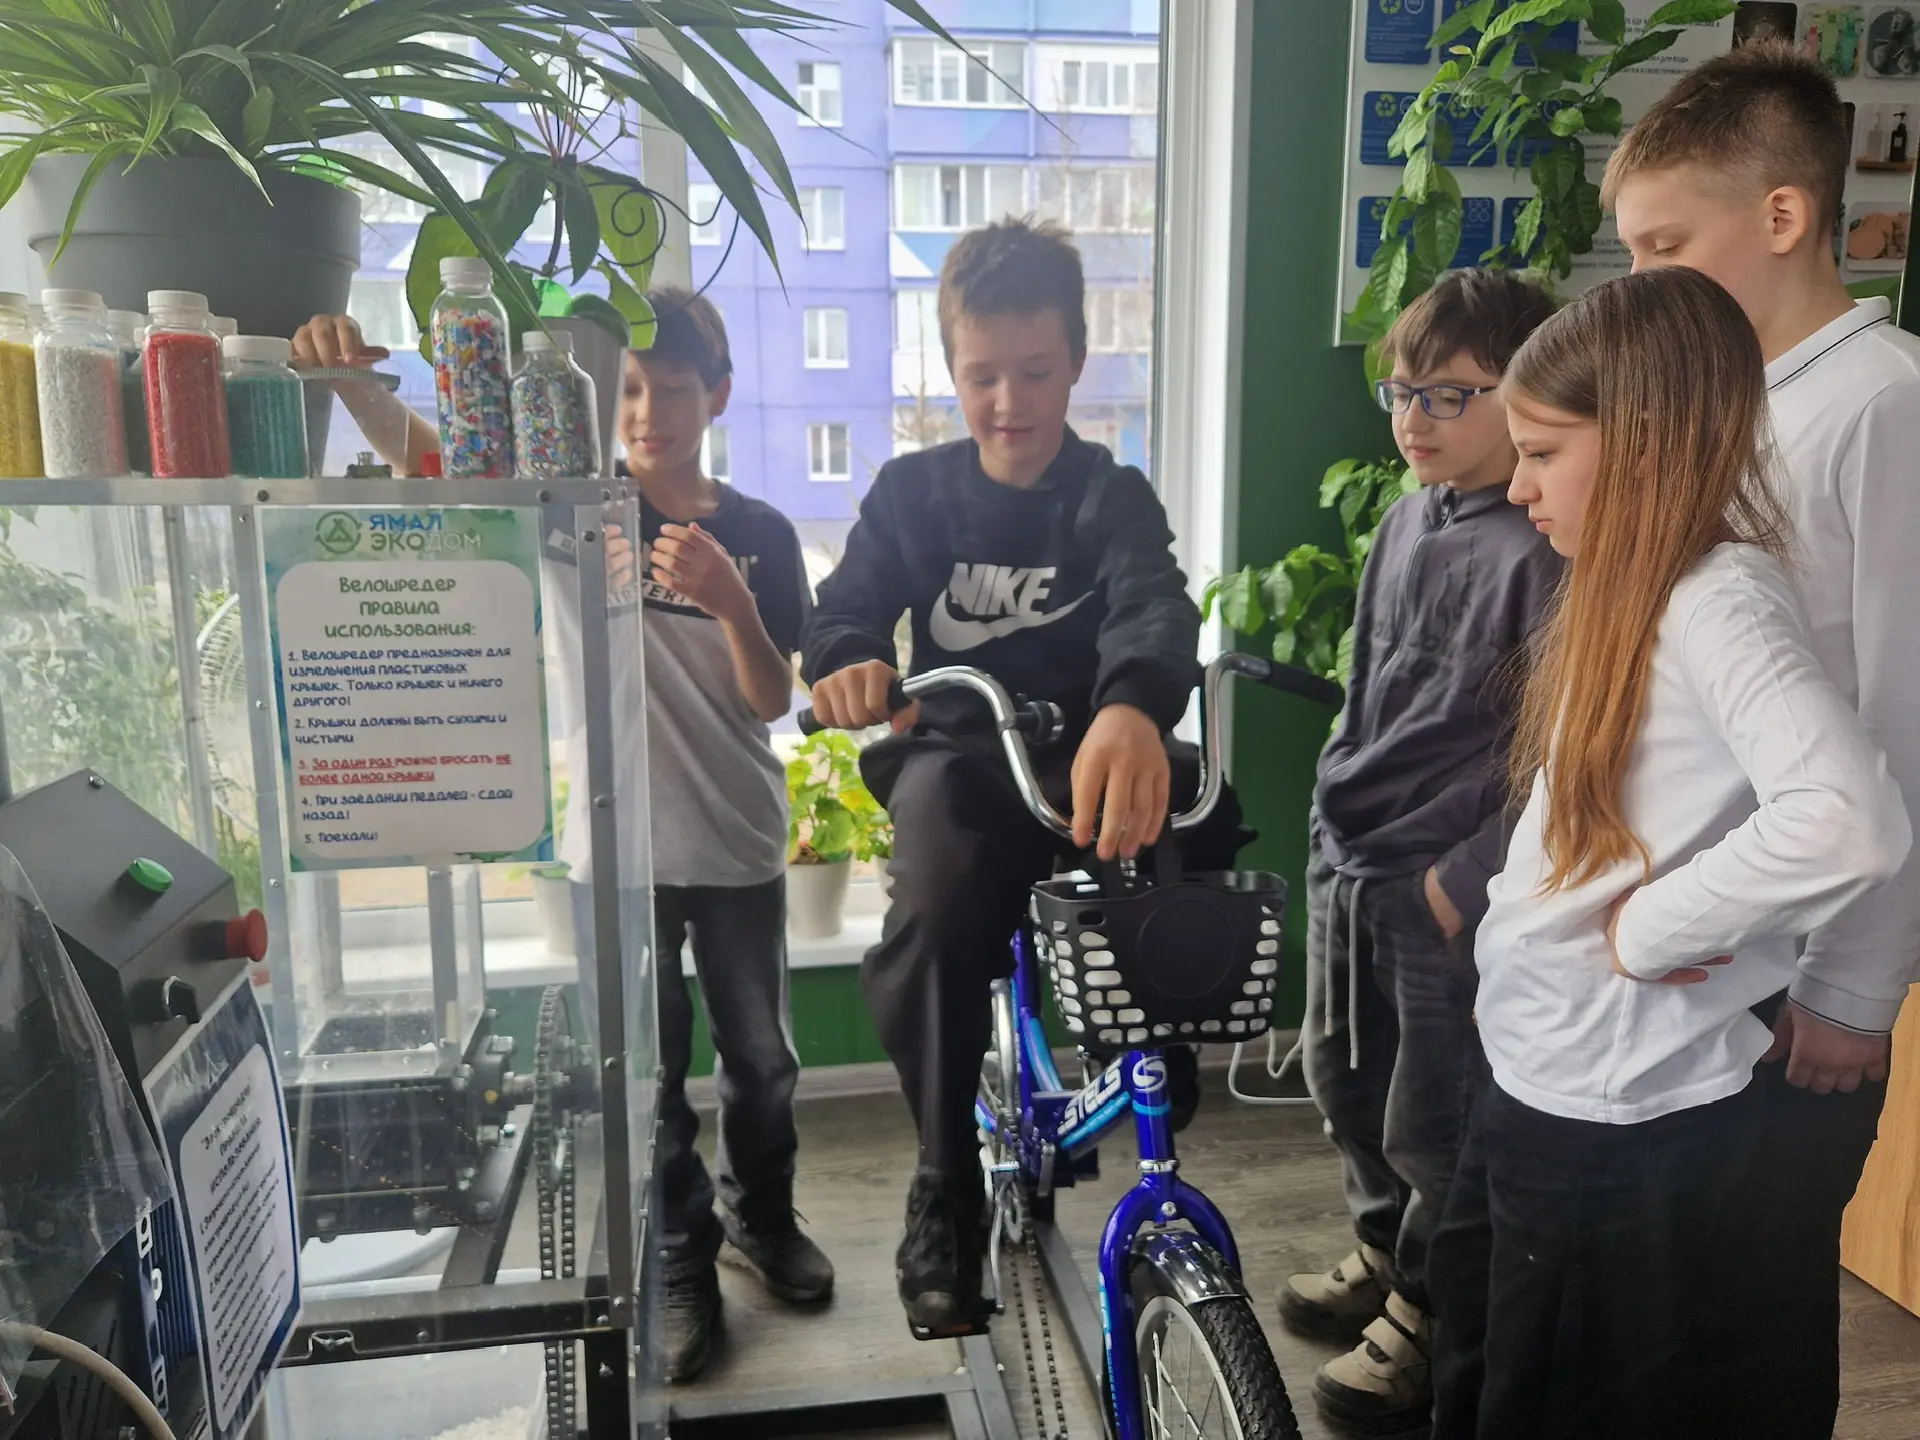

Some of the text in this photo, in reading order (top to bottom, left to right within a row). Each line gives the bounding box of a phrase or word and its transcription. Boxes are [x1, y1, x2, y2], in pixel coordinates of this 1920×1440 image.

[368, 513, 443, 531] ЯМАЛ
[371, 531, 482, 551] ЭКОДОМ
[339, 576, 457, 593] Велошредер
[949, 561, 1057, 616] NIKE
[359, 600, 440, 617] правила
[324, 622, 477, 638] использования:
[301, 648, 384, 661] Велошредер
[387, 648, 482, 660] предназначен
[486, 647, 511, 658] для
[288, 663, 468, 677] измельчения пластиковых
[346, 680, 393, 691] Только
[396, 679, 444, 690] крышек
[447, 680, 456, 688] и
[458, 678, 503, 689] ничего
[293, 696, 351, 708] другого!
[307, 717, 357, 729] Крышки
[359, 716, 412, 728] должны
[295, 734, 354, 745] чистыми
[1057, 1057, 1124, 1137] STELS
